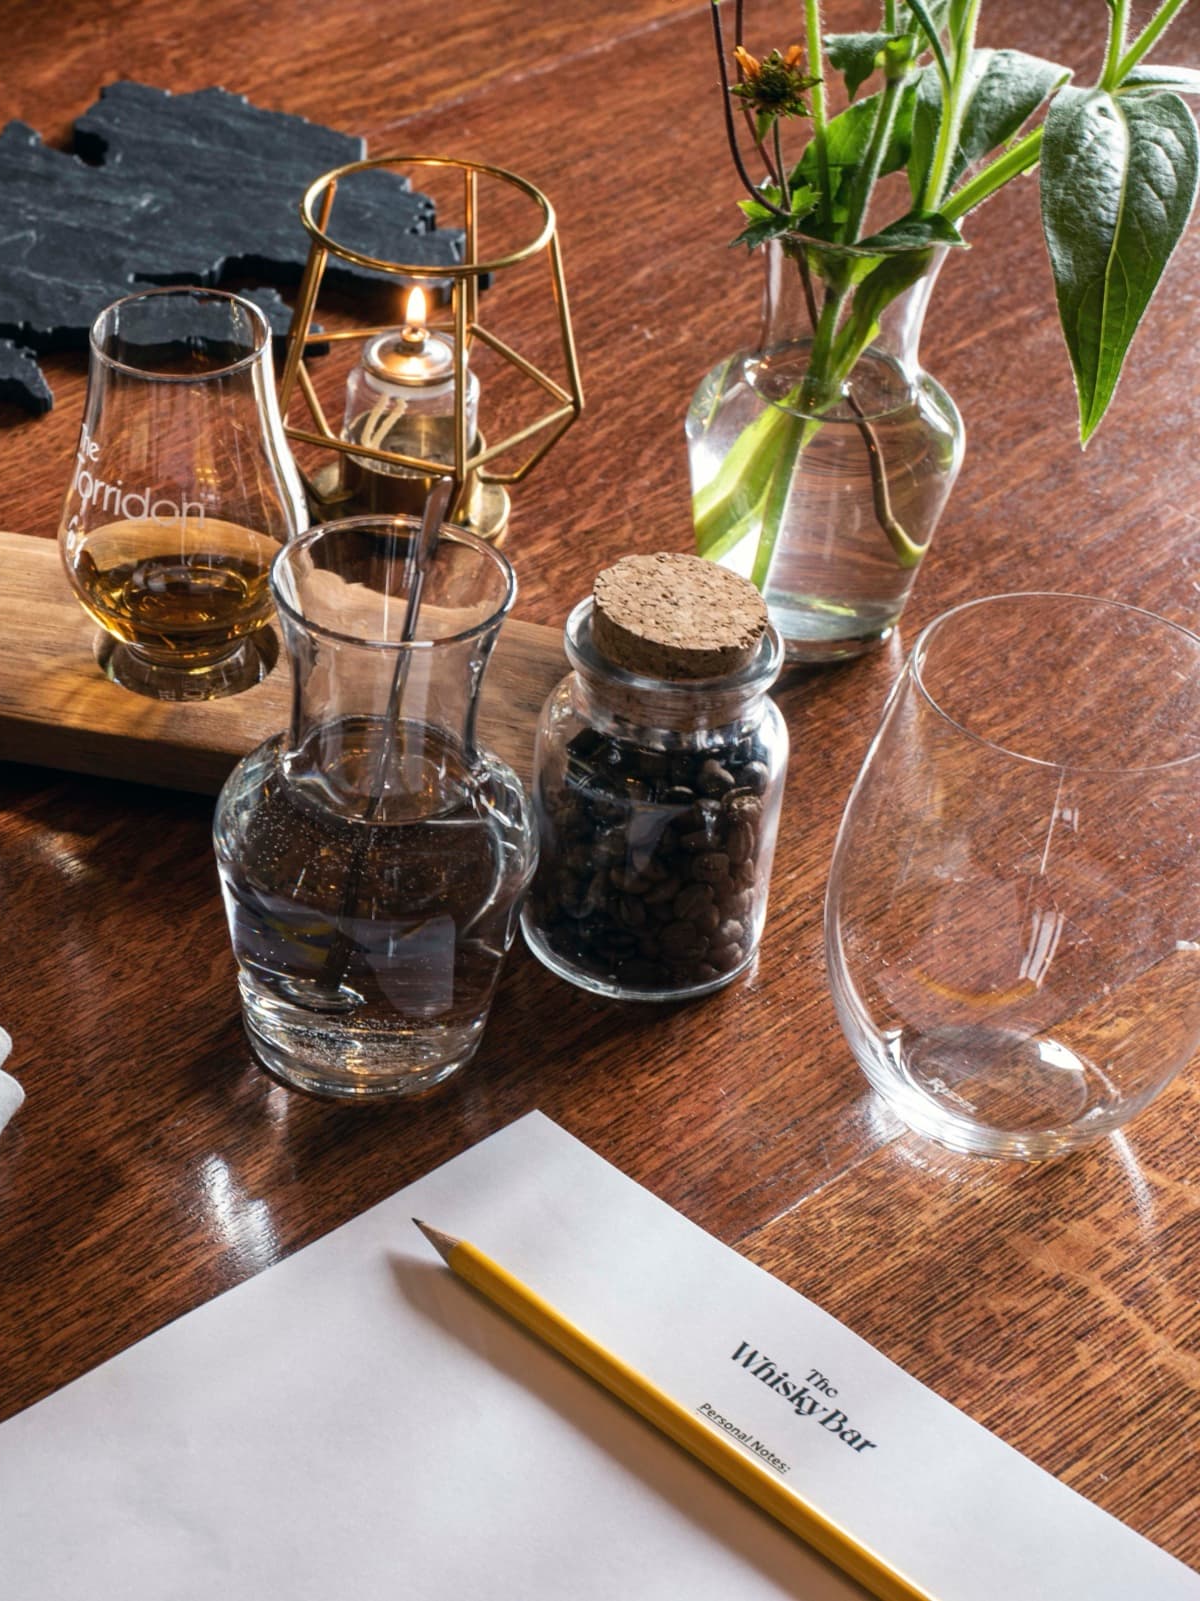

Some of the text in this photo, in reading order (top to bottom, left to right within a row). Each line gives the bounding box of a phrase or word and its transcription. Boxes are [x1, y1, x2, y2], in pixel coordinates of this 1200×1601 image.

[731, 1341, 878, 1453] Whisky Bar
[805, 1368, 838, 1398] The
[697, 1402, 791, 1473] Personal Notes:
